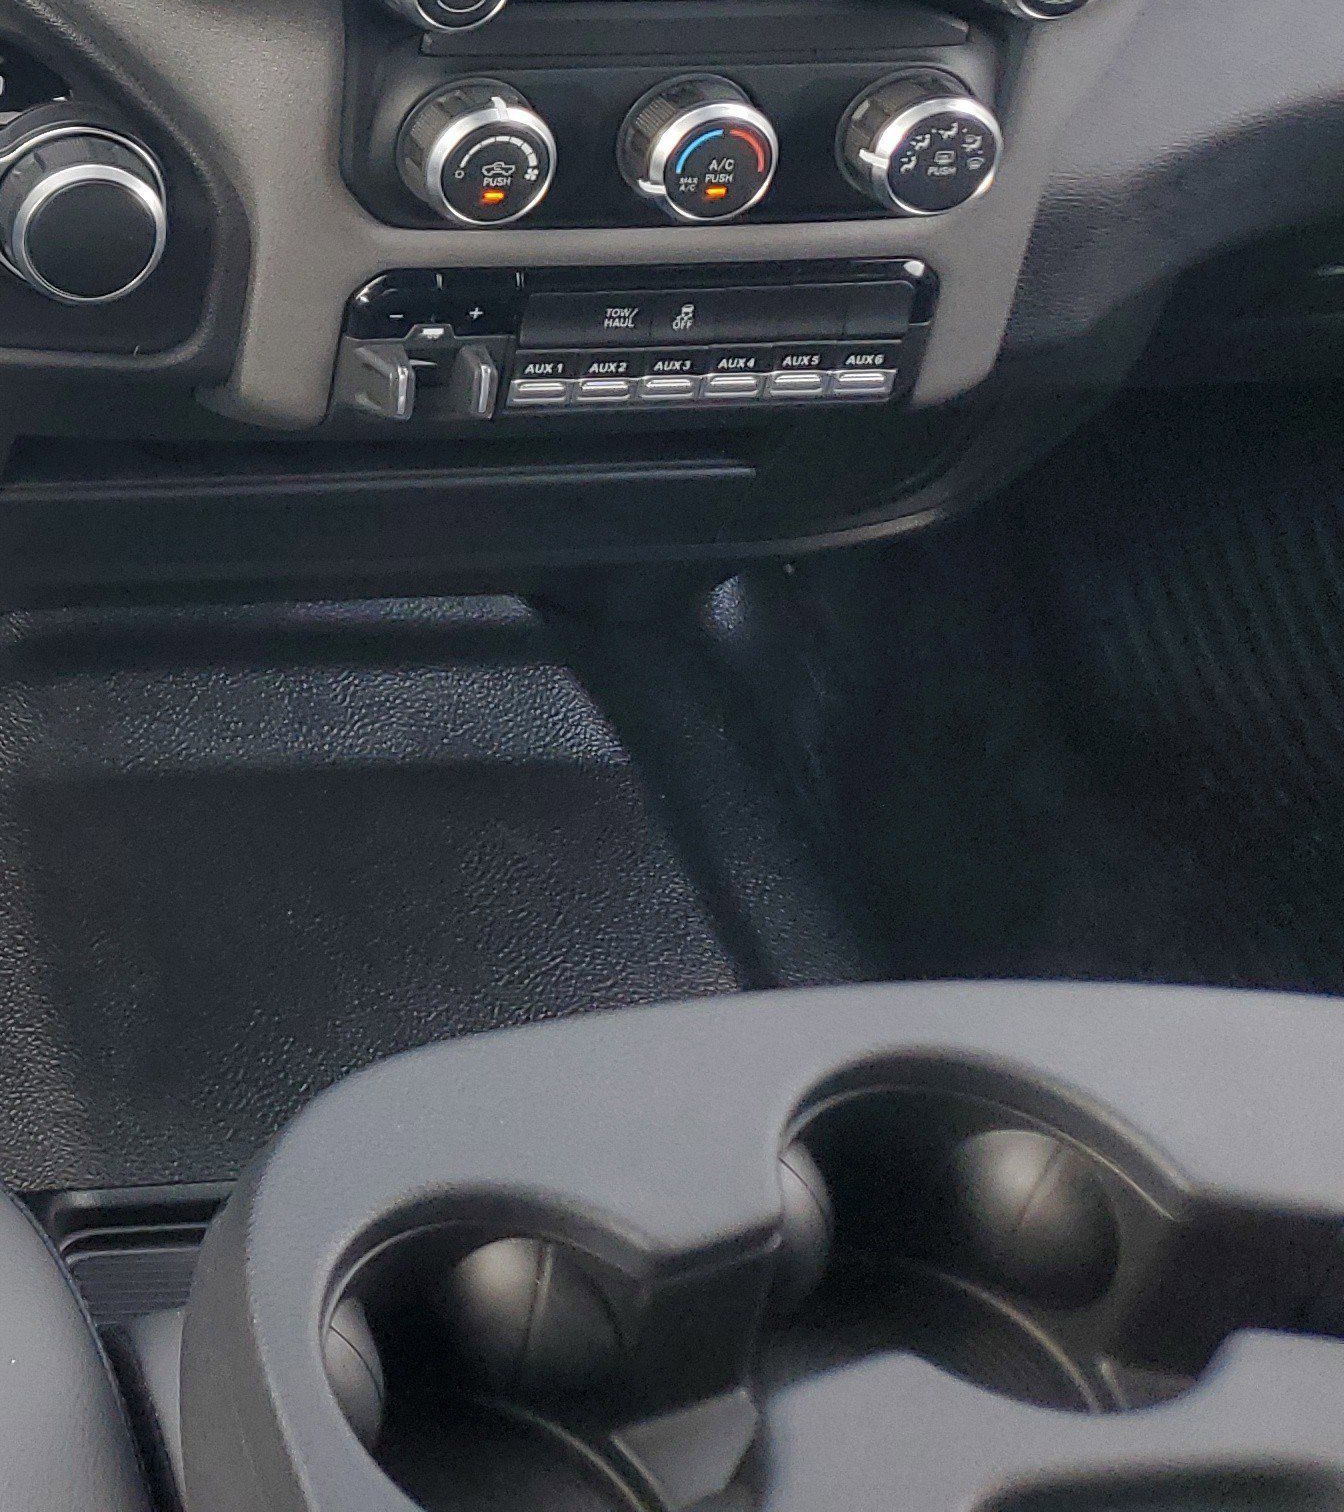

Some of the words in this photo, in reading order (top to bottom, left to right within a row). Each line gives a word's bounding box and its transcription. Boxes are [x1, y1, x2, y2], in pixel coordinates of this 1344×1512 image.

[709, 157, 736, 172] A/C
[482, 175, 512, 188] PUSH
[705, 173, 735, 184] PUSH
[603, 317, 636, 329] HAUL
[672, 319, 693, 331] OFF
